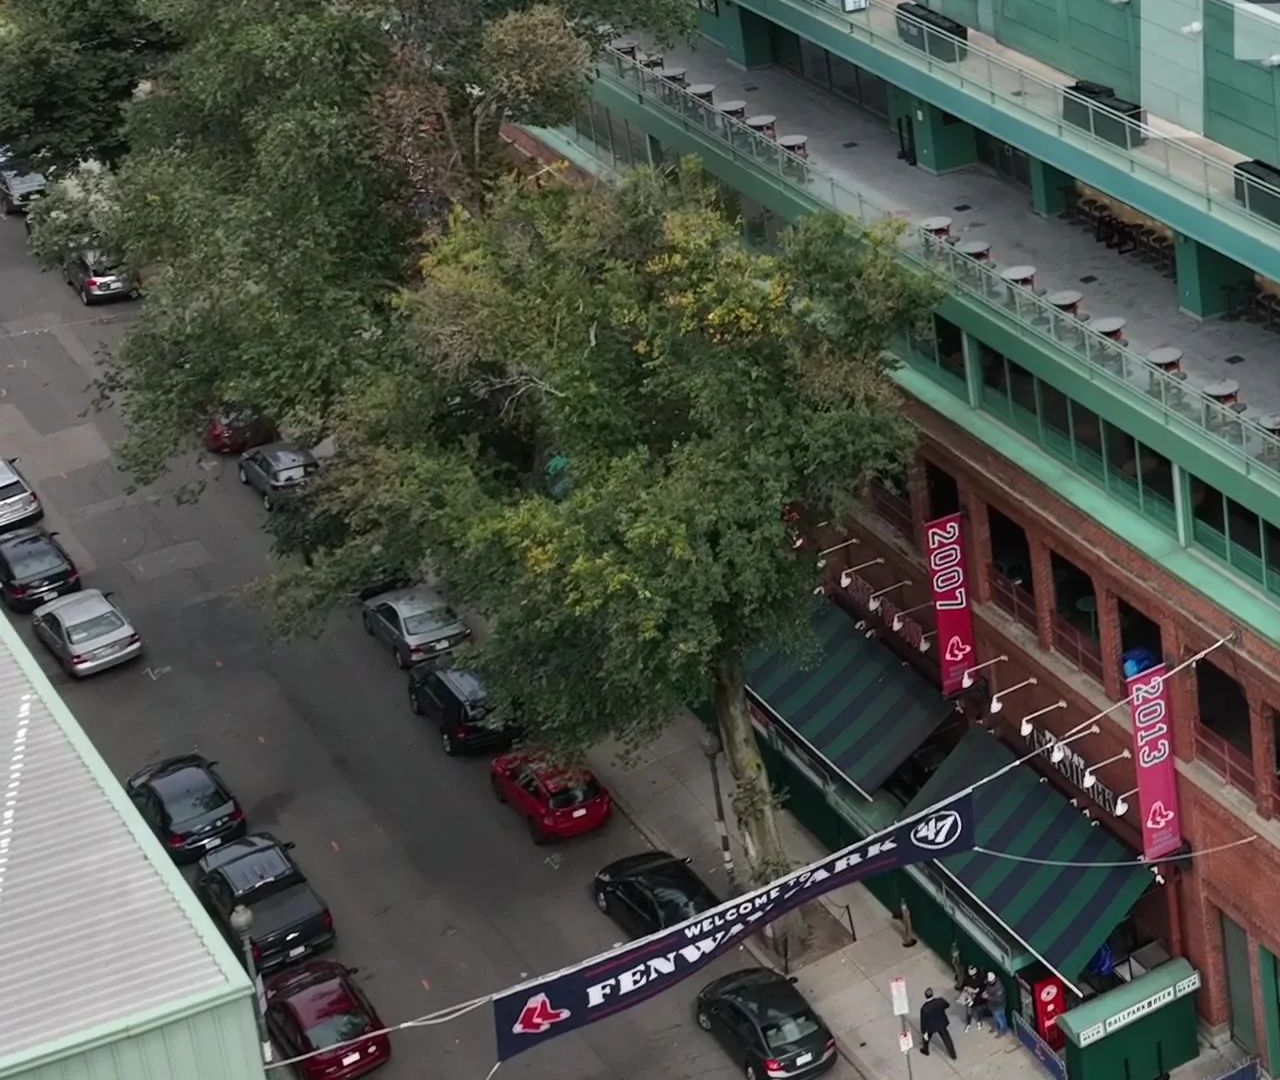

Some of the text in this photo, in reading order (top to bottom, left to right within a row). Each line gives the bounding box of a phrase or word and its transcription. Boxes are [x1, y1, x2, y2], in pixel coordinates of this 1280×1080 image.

[928, 522, 967, 610] 2007
[1133, 676, 1169, 768] 2013
[784, 835, 898, 900] ARK
[684, 873, 809, 939] WELCOME TO
[1108, 990, 1172, 1028] BALLPARK BEER
